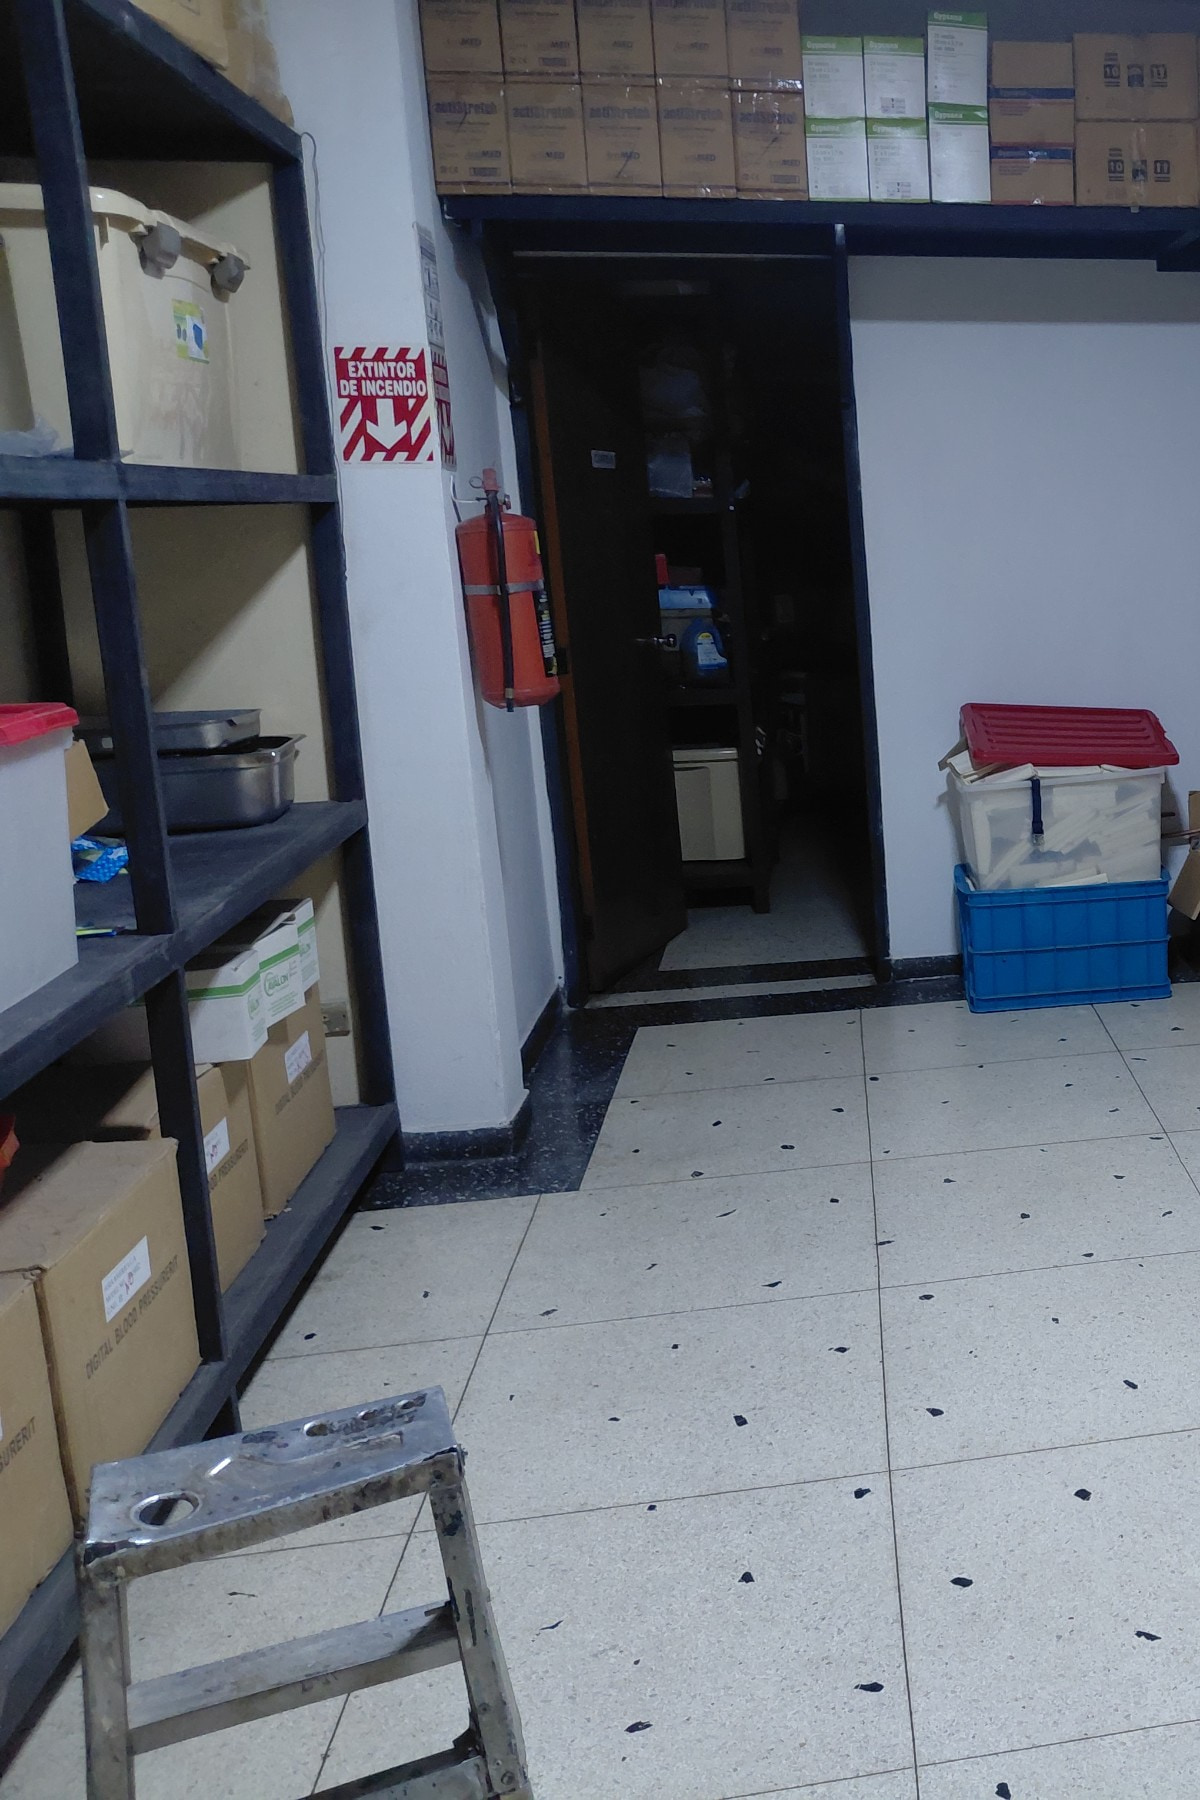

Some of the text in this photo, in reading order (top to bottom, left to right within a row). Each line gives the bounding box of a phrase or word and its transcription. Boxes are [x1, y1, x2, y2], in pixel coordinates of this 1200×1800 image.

[348, 361, 416, 378] EXTINTOR
[340, 380, 358, 396] DE
[362, 380, 427, 396] INCENDIO
[85, 1337, 113, 1380] DIGITAL
[114, 1307, 139, 1345] BLOOD
